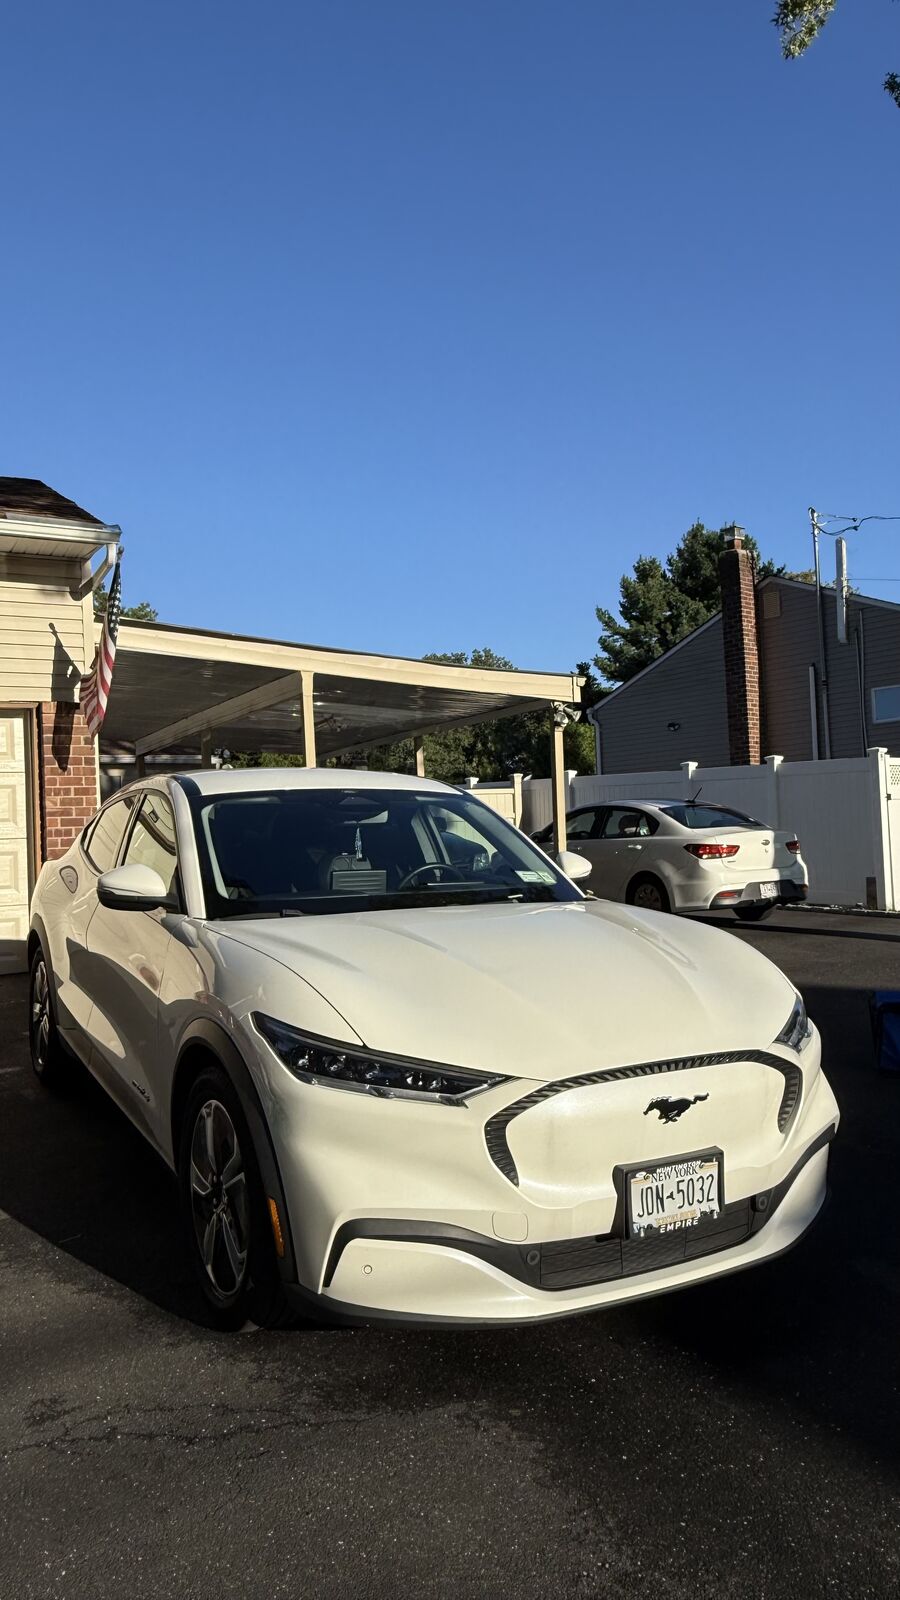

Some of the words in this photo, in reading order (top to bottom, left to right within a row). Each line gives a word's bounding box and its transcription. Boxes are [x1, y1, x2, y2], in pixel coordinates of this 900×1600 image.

[651, 1166, 673, 1183] NEW
[674, 1165, 698, 1179] YORK
[677, 1173, 715, 1209] 5032
[659, 1216, 699, 1234] EMPIRE
